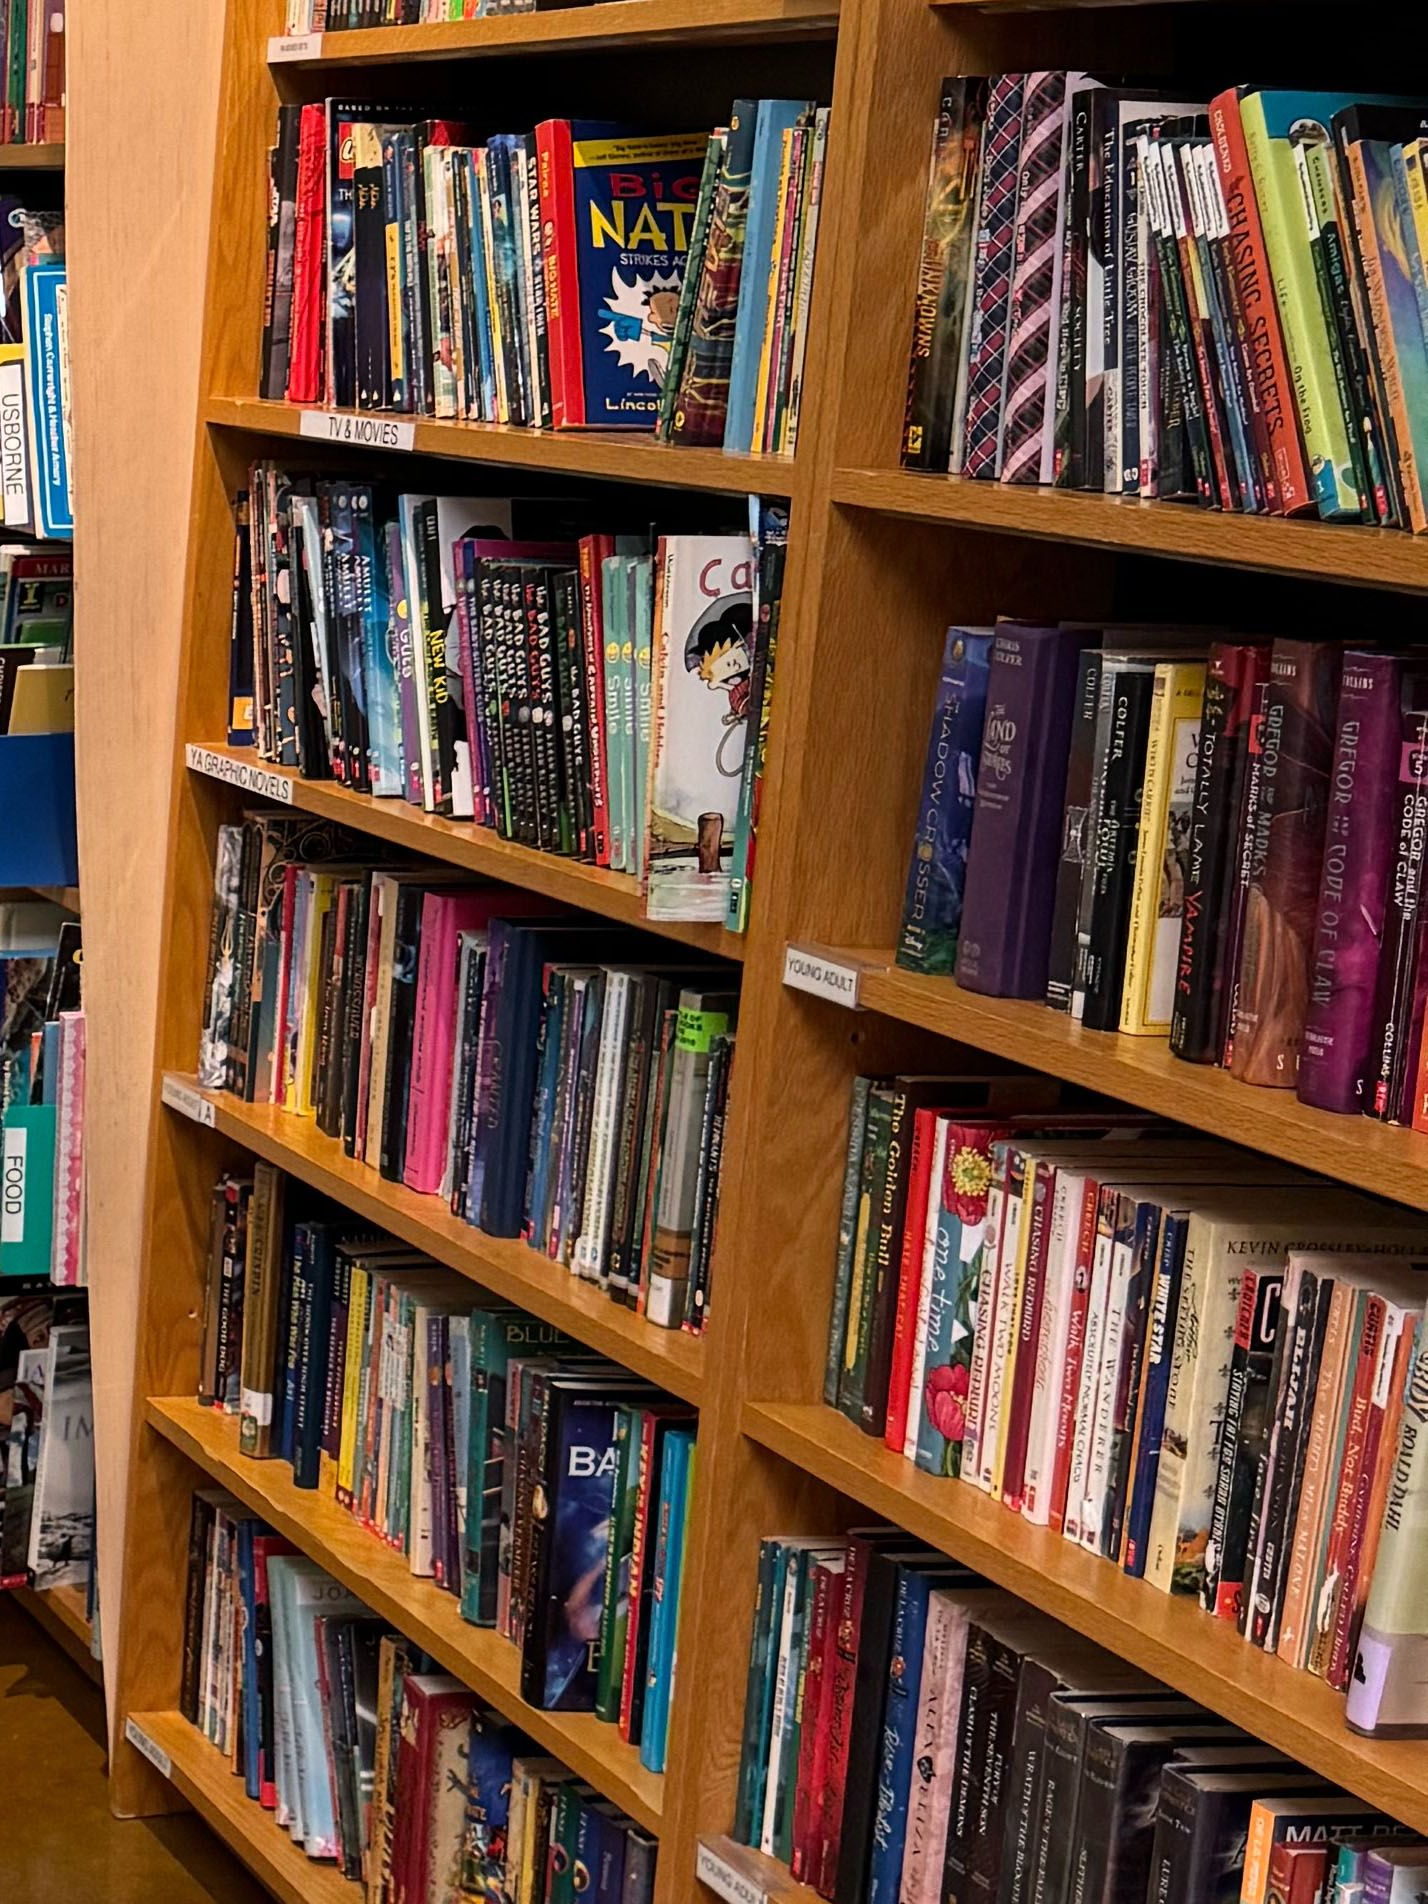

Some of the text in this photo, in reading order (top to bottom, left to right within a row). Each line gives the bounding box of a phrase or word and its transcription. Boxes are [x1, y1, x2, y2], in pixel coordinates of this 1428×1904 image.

[1075, 112, 1086, 172] CARTER
[527, 156, 541, 256] STAR WARS
[590, 199, 696, 251] NAT
[1104, 162, 1114, 238] Education
[620, 254, 668, 266] STRIKES
[917, 243, 943, 358] UNKNOWNS
[1226, 192, 1283, 436] CHASING SECRETS
[329, 417, 399, 446] TV & MOVIES
[605, 398, 664, 411] Lincol
[2, 393, 24, 497] USBORNE
[429, 629, 448, 704] NEW KID
[540, 654, 552, 703] GUYS
[1083, 668, 1097, 720] COLFER
[607, 675, 620, 735] Smile
[1113, 696, 1127, 759] COLFER
[1263, 704, 1284, 778] GREGOR
[190, 747, 289, 799] YA GRAPHIC NOVELS
[928, 694, 960, 805] SHADOW
[1333, 721, 1360, 804] GREGOR
[1241, 762, 1260, 888] MARKS SECRET
[1180, 733, 1217, 995] TOTALLY LAME VAMPIRE
[787, 956, 854, 994] YOUNG ADULT
[5, 1155, 23, 1214] FOOD
[877, 1139, 902, 1266] Golden Bull
[1227, 1241, 1278, 1255] KEVIN
[926, 1226, 953, 1353] one time
[973, 1268, 992, 1340] CHASING
[1057, 1309, 1082, 1448] Walk Moons
[1095, 1357, 1117, 1474] WANDERER
[1334, 1476, 1355, 1537] Buddy
[1385, 1424, 1418, 1532] ROALD DAHL
